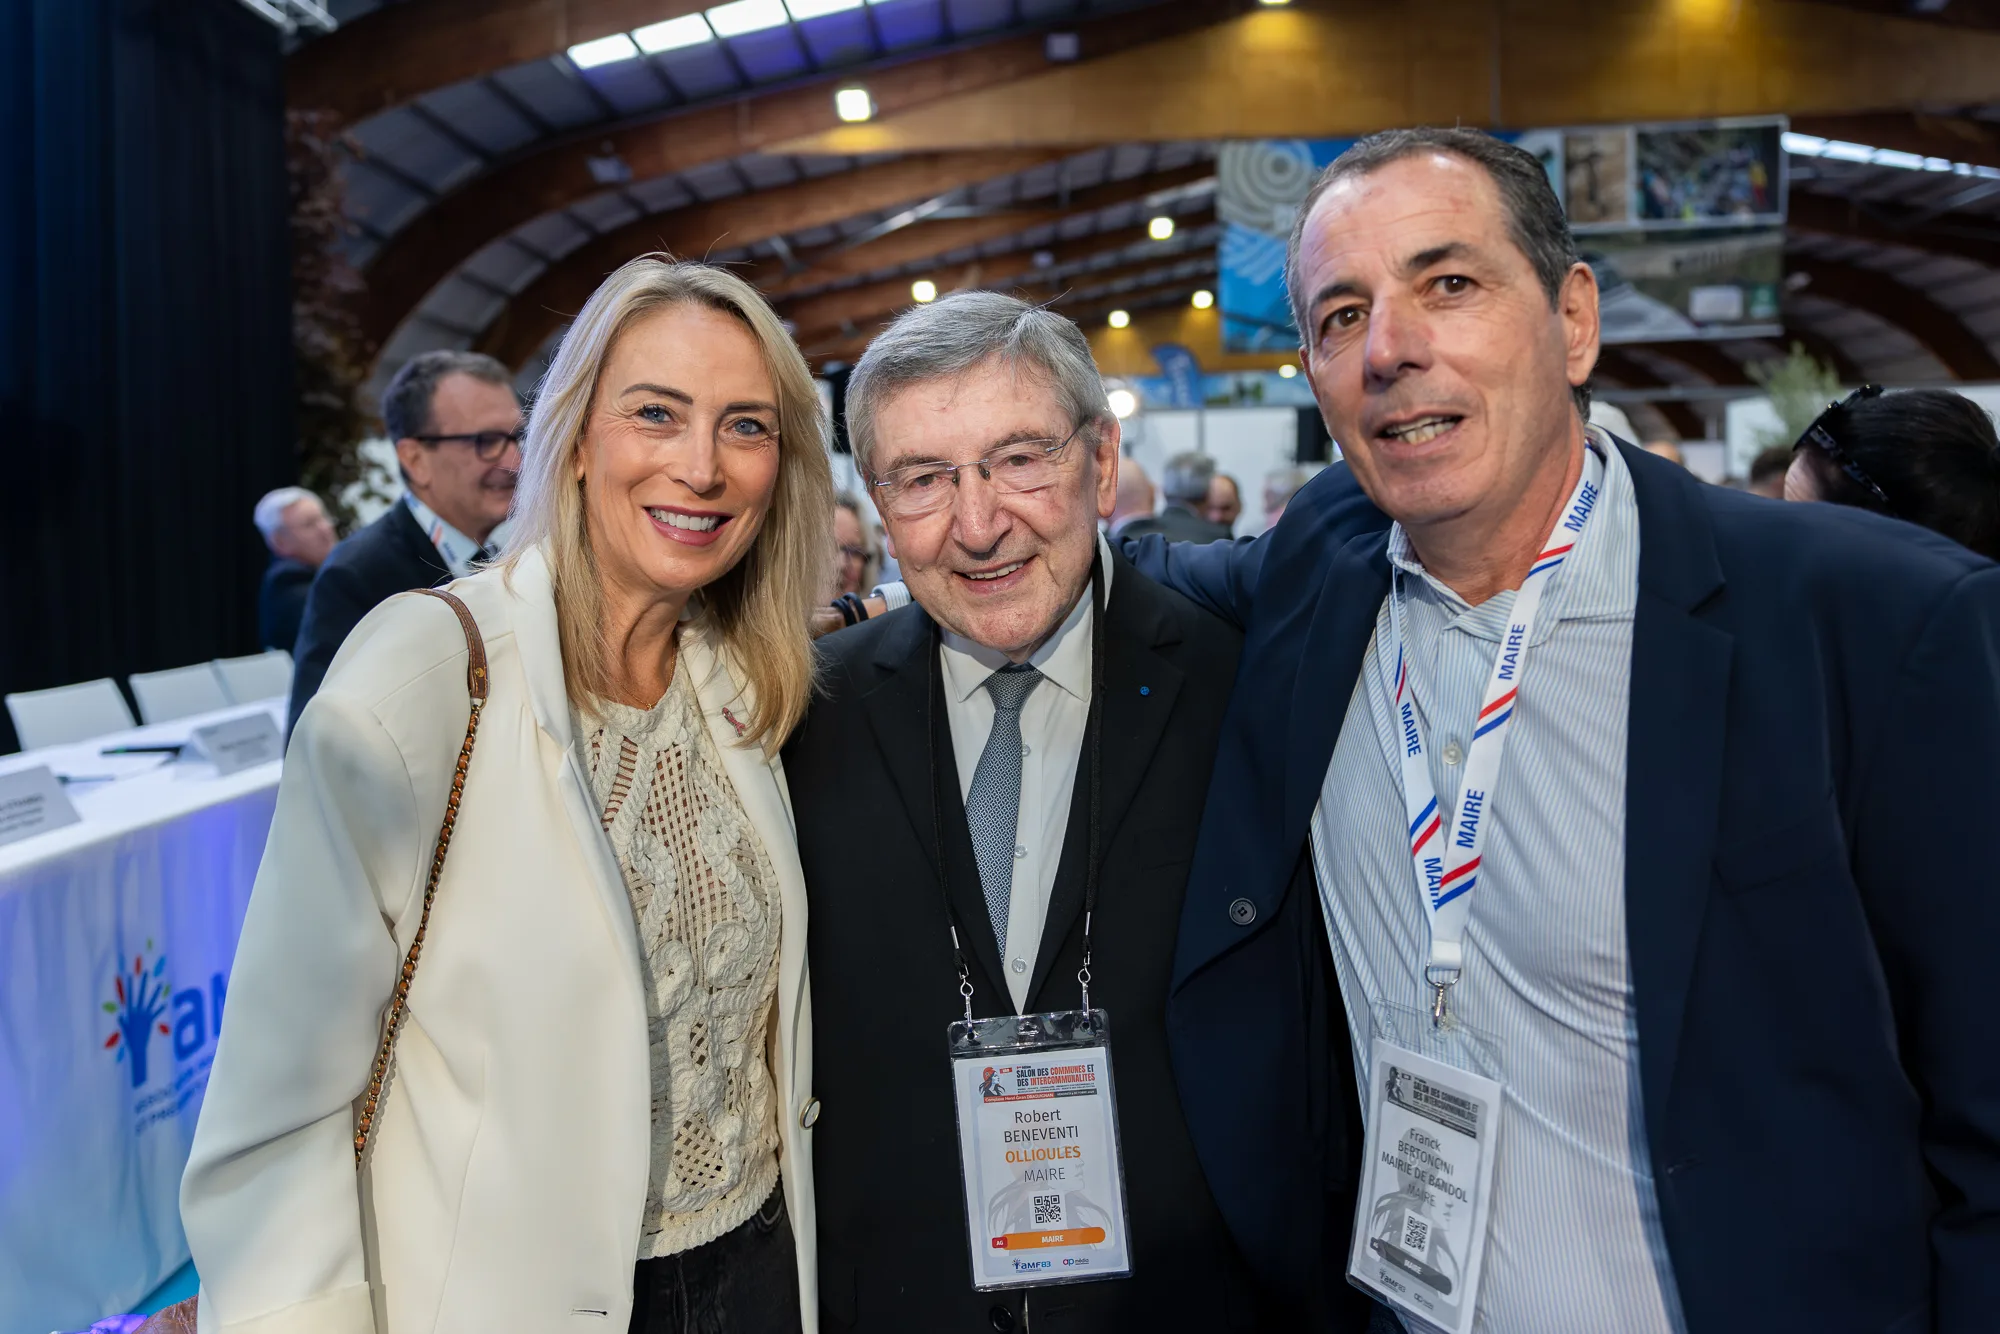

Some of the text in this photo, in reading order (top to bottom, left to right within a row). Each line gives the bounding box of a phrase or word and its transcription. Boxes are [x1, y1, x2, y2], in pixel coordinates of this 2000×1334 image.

[1564, 481, 1599, 532] MAIRE
[1498, 624, 1526, 680] MAIRE
[1401, 703, 1421, 758] MAIRE
[1456, 789, 1485, 848] MAIRE
[1016, 1068, 1036, 1078] SALON
[1037, 1067, 1049, 1076] DES
[1050, 1065, 1086, 1075] COMMUNES
[1087, 1064, 1094, 1072] ET
[1017, 1078, 1029, 1087] DES
[1015, 1109, 1061, 1123] Robert
[1004, 1126, 1079, 1143] BENEVENTI
[1409, 1128, 1441, 1152] Franck
[1005, 1146, 1081, 1163] OLLIOULES
[1398, 1140, 1454, 1176] BERTONCINI
[1024, 1167, 1065, 1182] MAIRE
[1382, 1151, 1468, 1203] MAIRIE DE BANDOL
[1407, 1184, 1436, 1207] MAIRE
[1041, 1235, 1064, 1243] MAIRE
